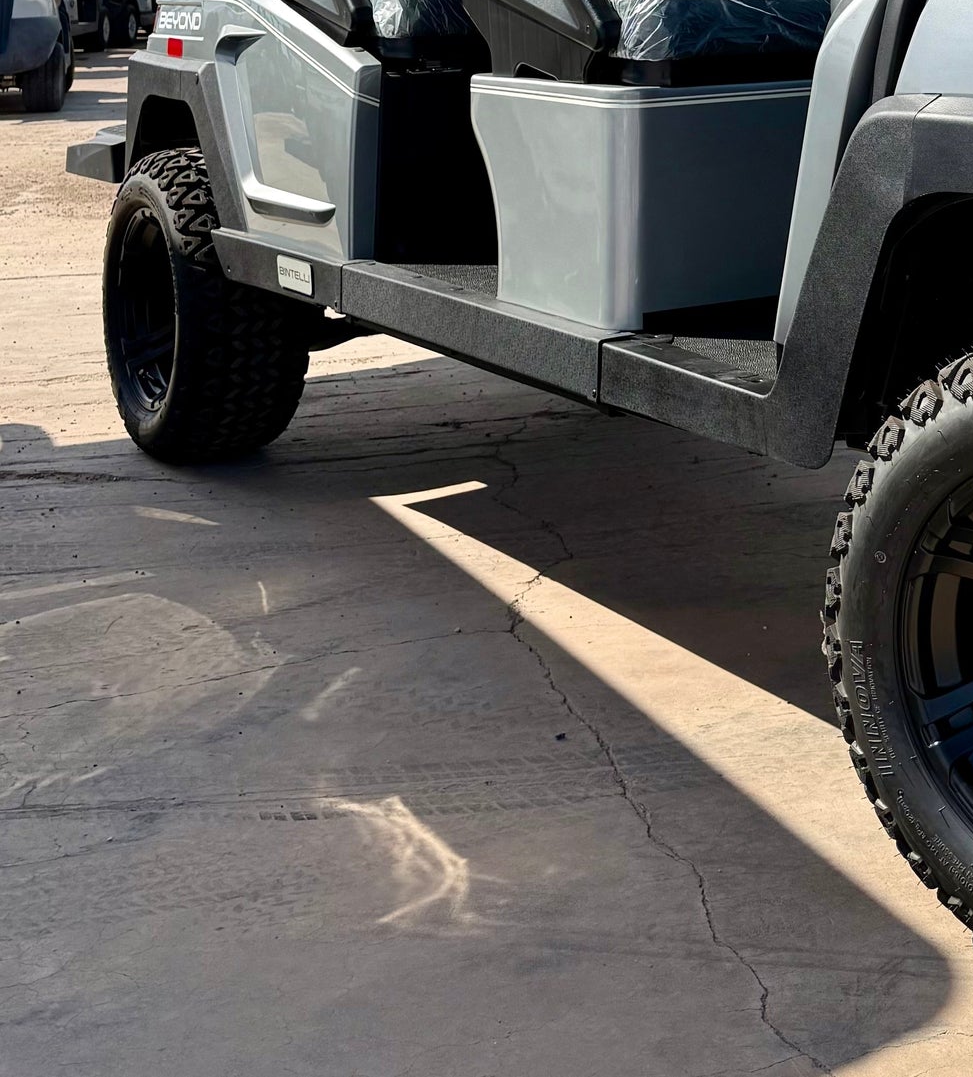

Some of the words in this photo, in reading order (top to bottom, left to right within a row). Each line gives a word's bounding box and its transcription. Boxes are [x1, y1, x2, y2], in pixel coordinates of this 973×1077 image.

[158, 11, 202, 31] BEYOND
[279, 265, 311, 284] BINTELLI
[850, 639, 895, 777] INNOVA
